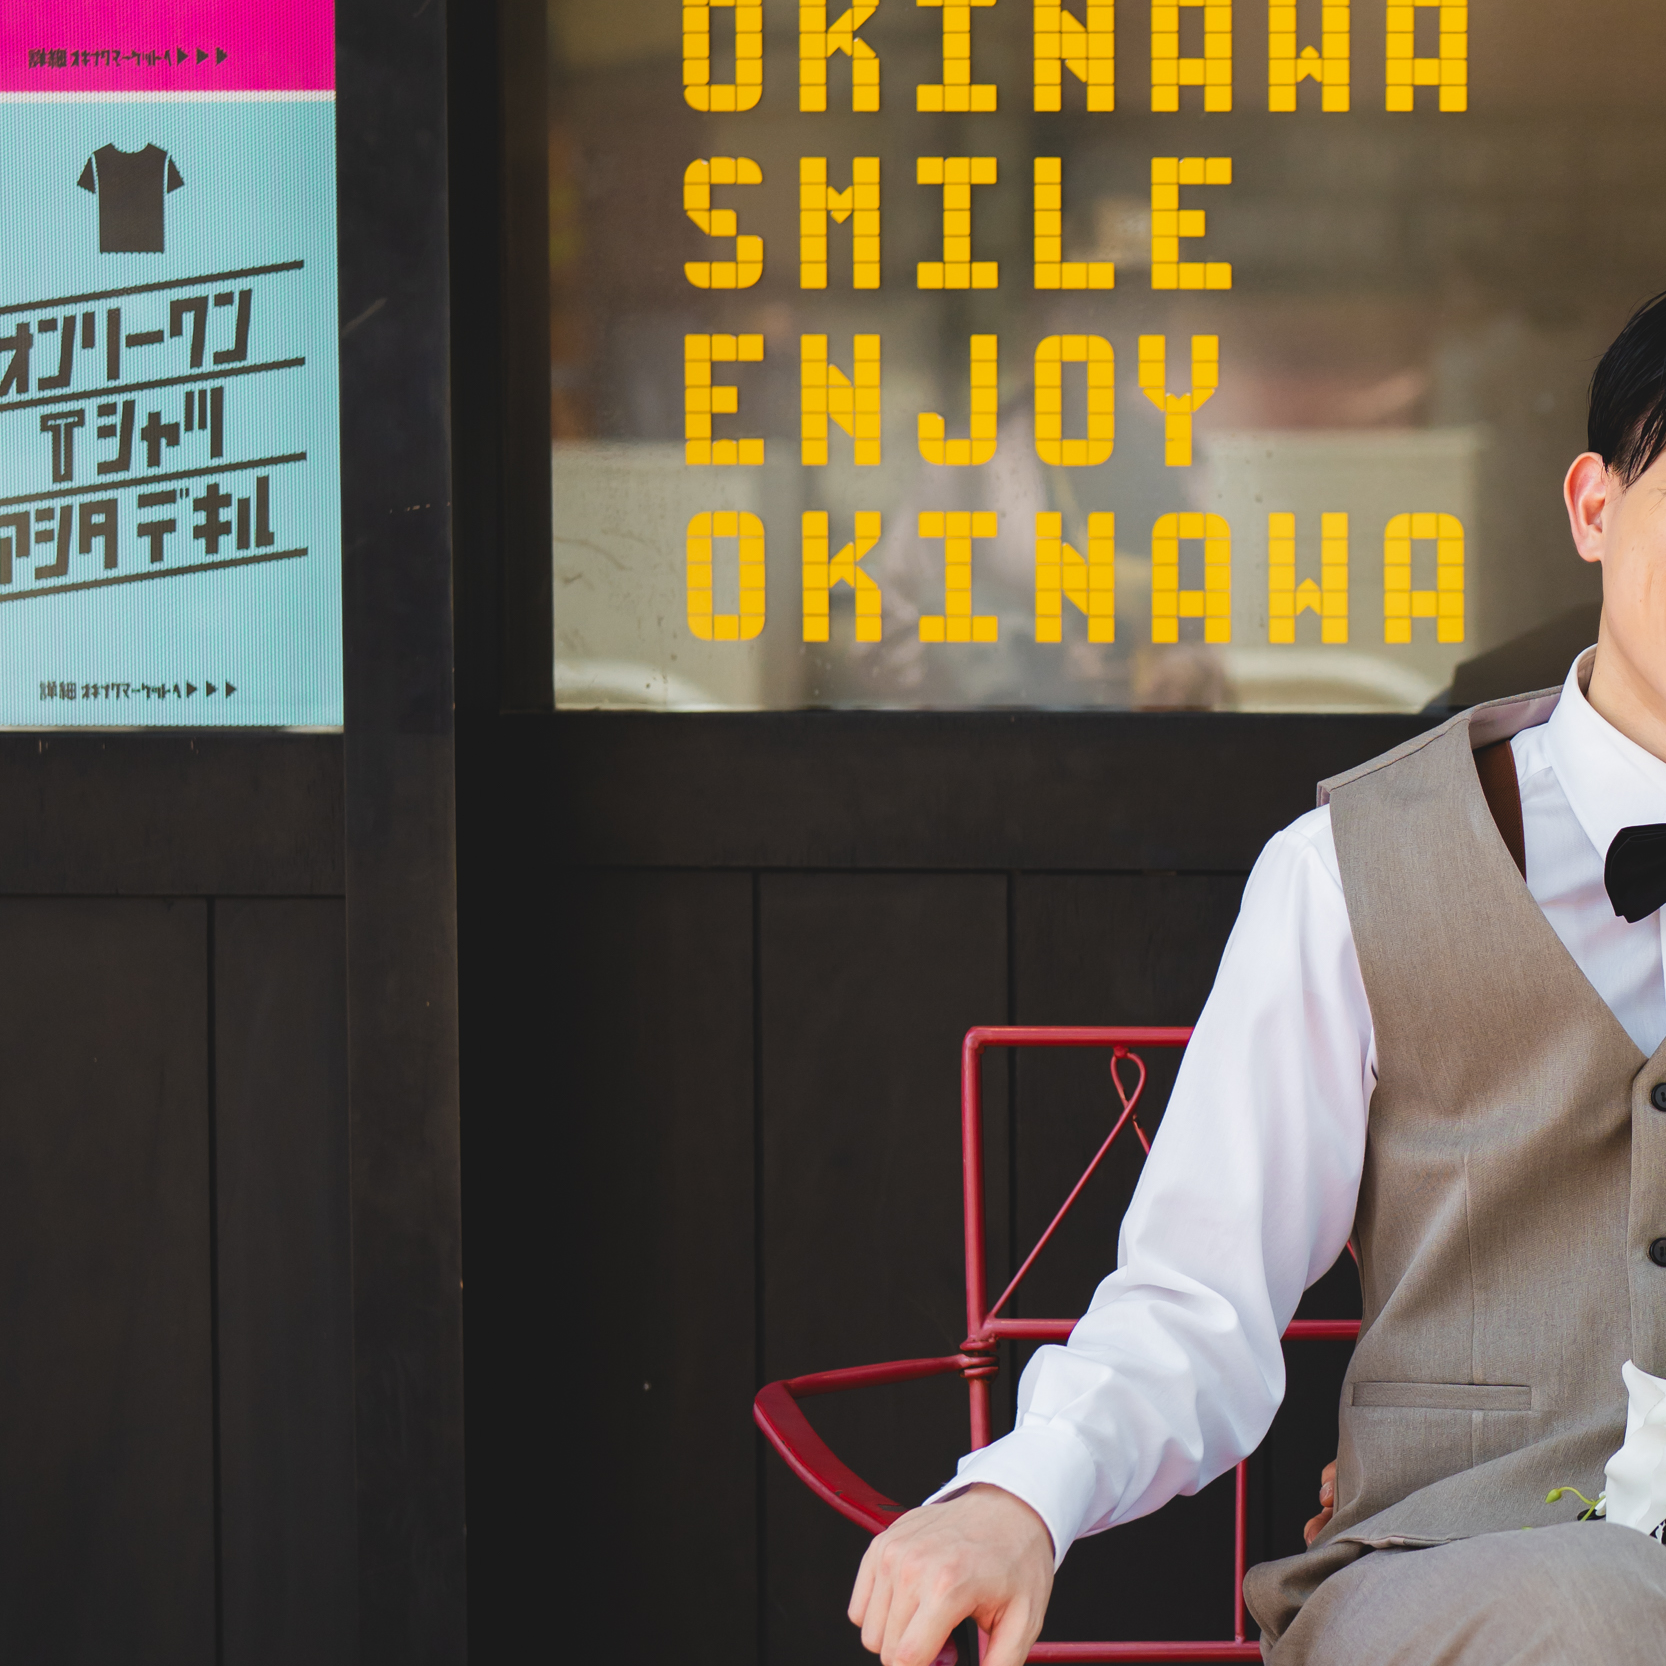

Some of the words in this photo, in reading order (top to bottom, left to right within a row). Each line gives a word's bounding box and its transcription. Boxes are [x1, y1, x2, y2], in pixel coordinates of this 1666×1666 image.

[683, 157, 1233, 290] SMILE
[40, 385, 225, 484] Tシャツ
[684, 334, 1219, 467] ENJOY
[686, 510, 1466, 644] OKINAWA
